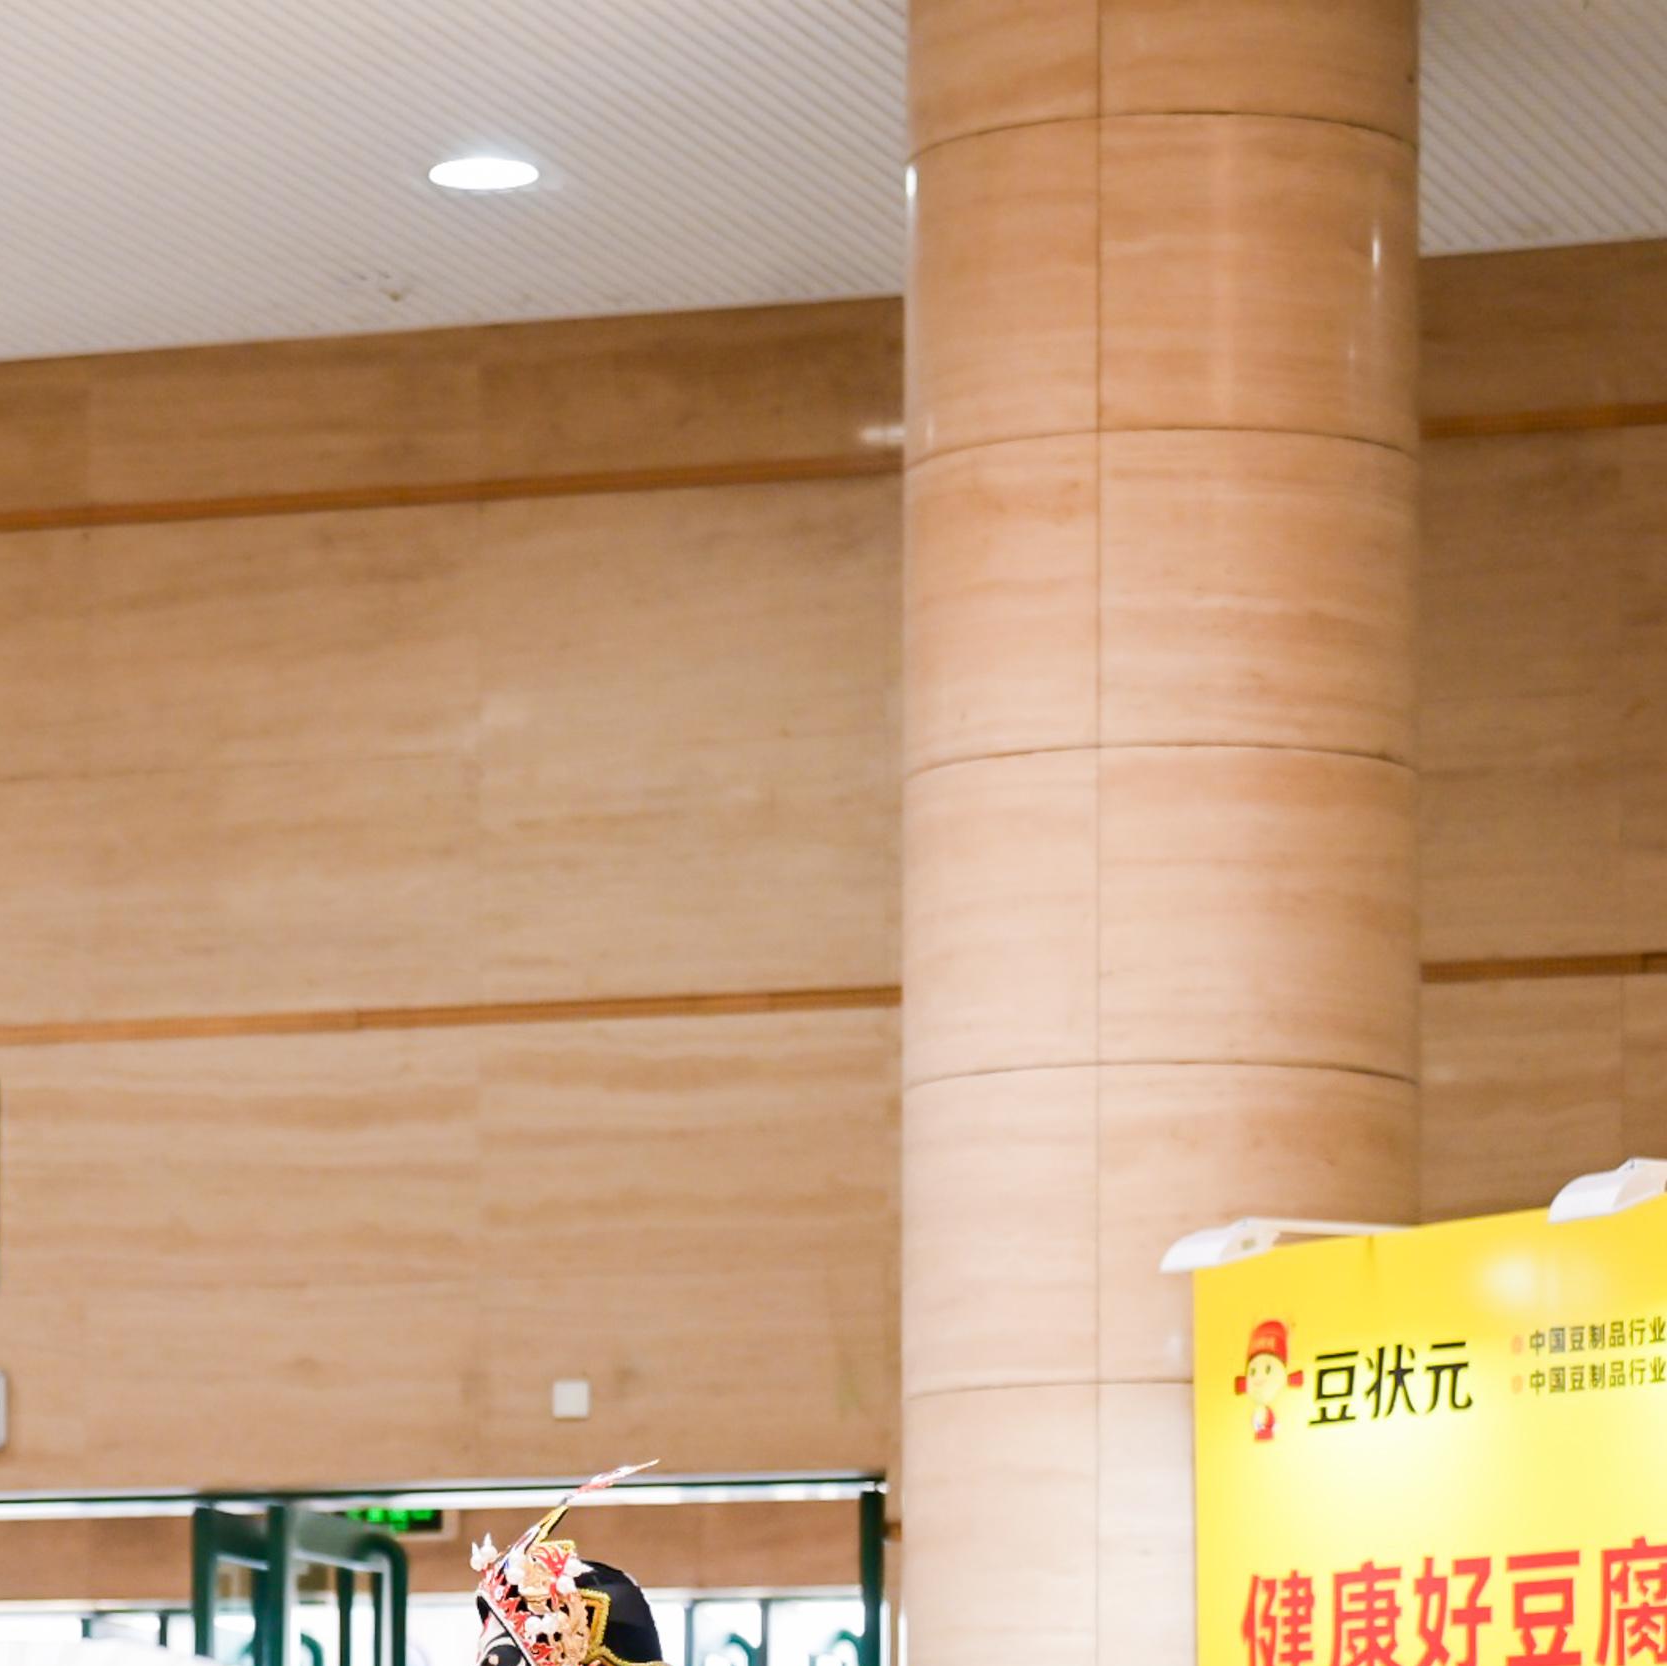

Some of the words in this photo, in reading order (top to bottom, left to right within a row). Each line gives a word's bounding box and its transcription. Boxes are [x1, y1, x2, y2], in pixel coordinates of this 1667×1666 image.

[1529, 1316, 1666, 1356] 中国豆制品行业
[1308, 1341, 1473, 1427] 豆状元
[1529, 1356, 1666, 1396] 中国豆制品行业
